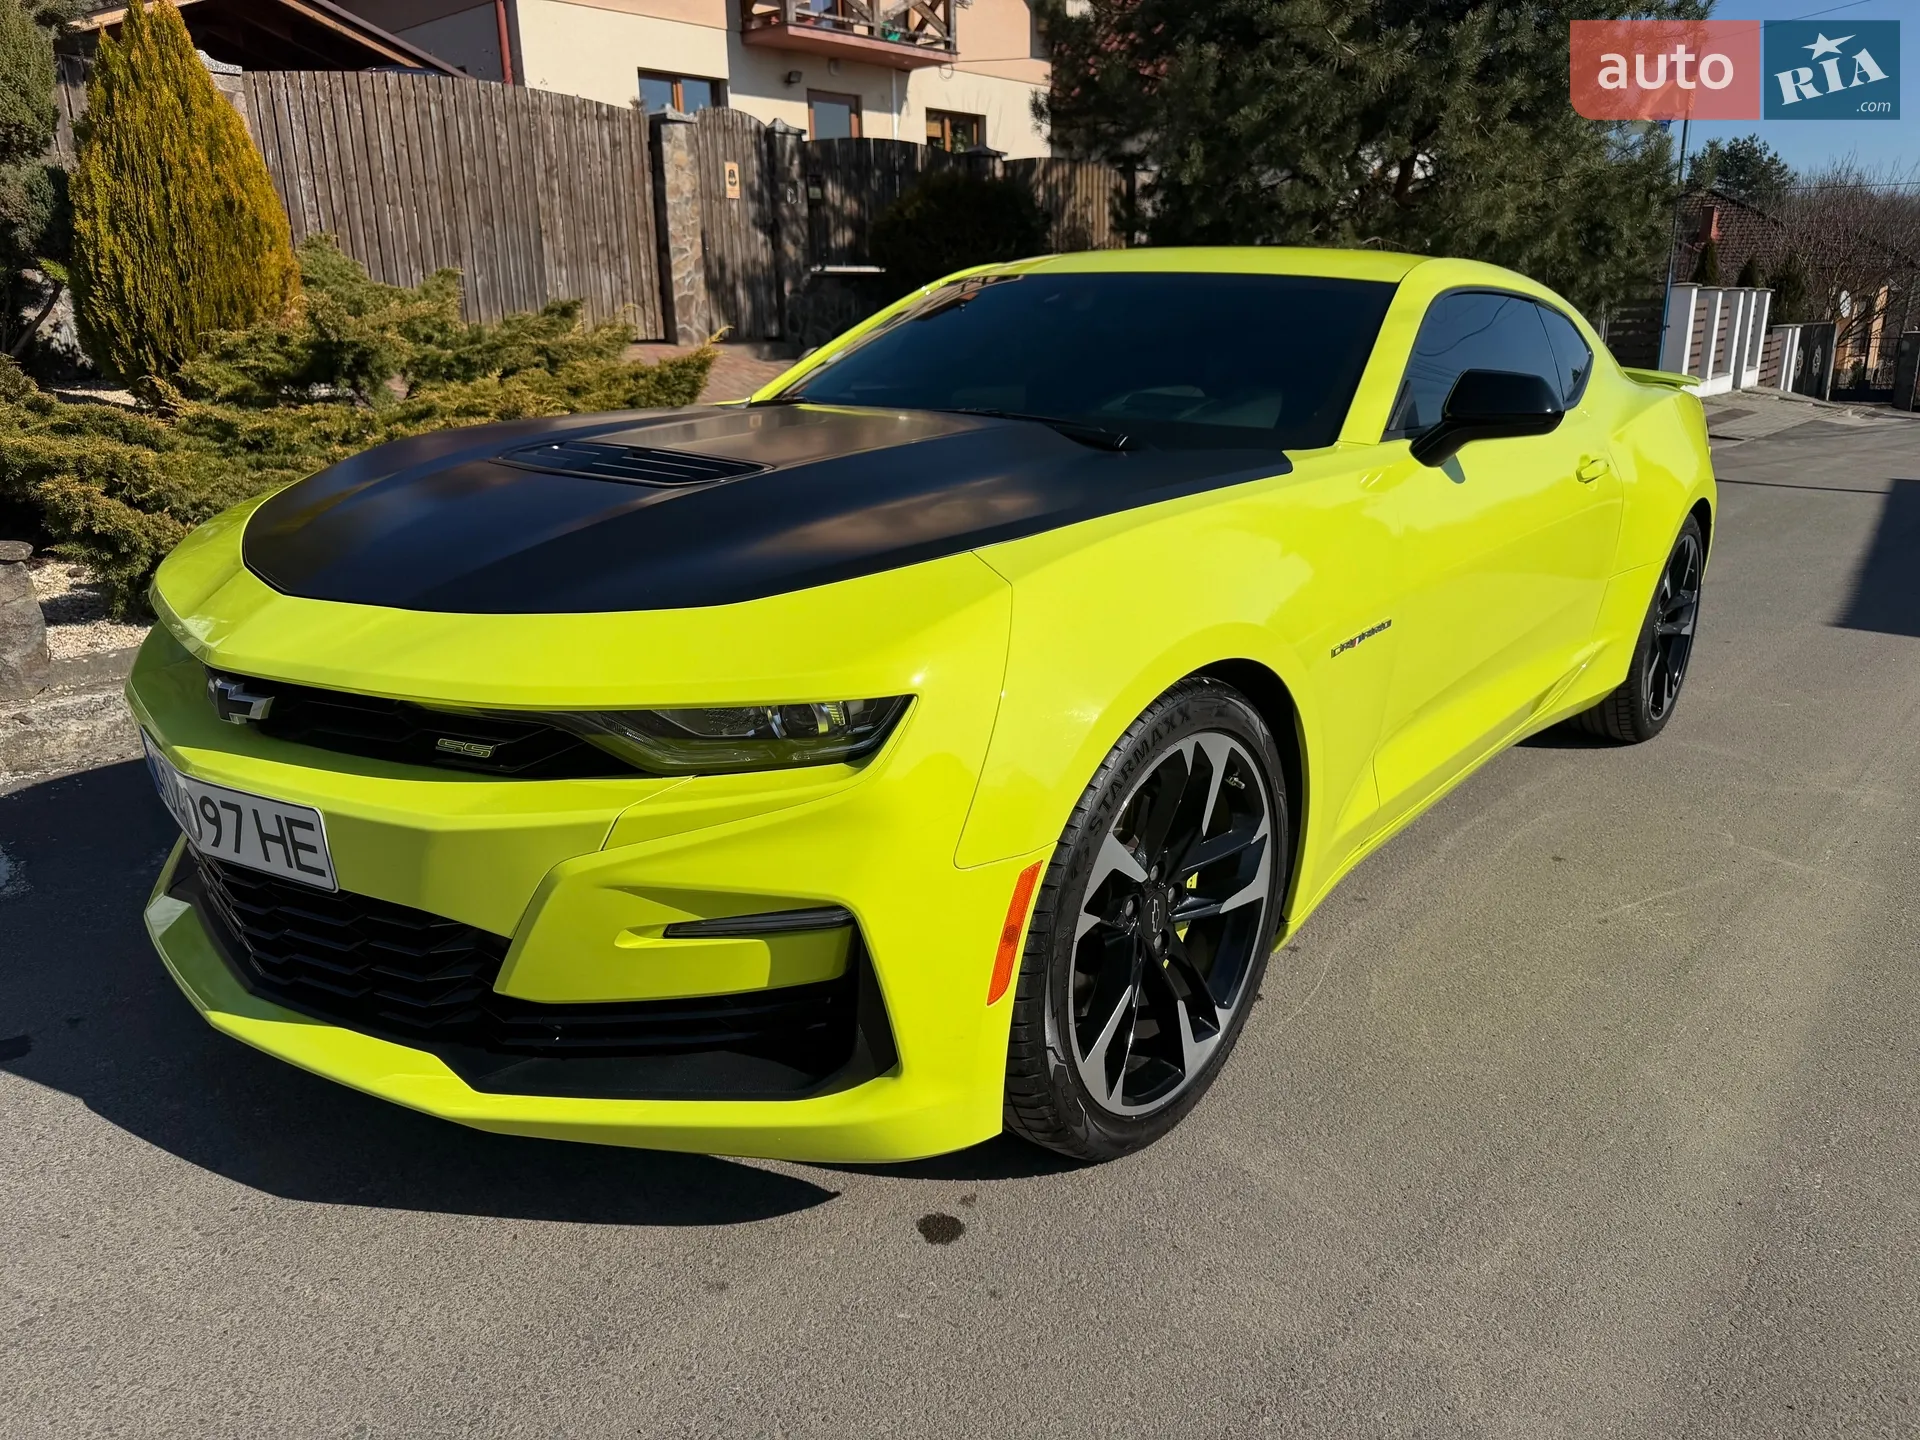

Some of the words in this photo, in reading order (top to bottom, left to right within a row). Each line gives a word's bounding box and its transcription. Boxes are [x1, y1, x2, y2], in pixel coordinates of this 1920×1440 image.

[436, 738, 493, 758] SS
[1088, 703, 1192, 836] STARMAXX
[252, 808, 326, 878] HE
